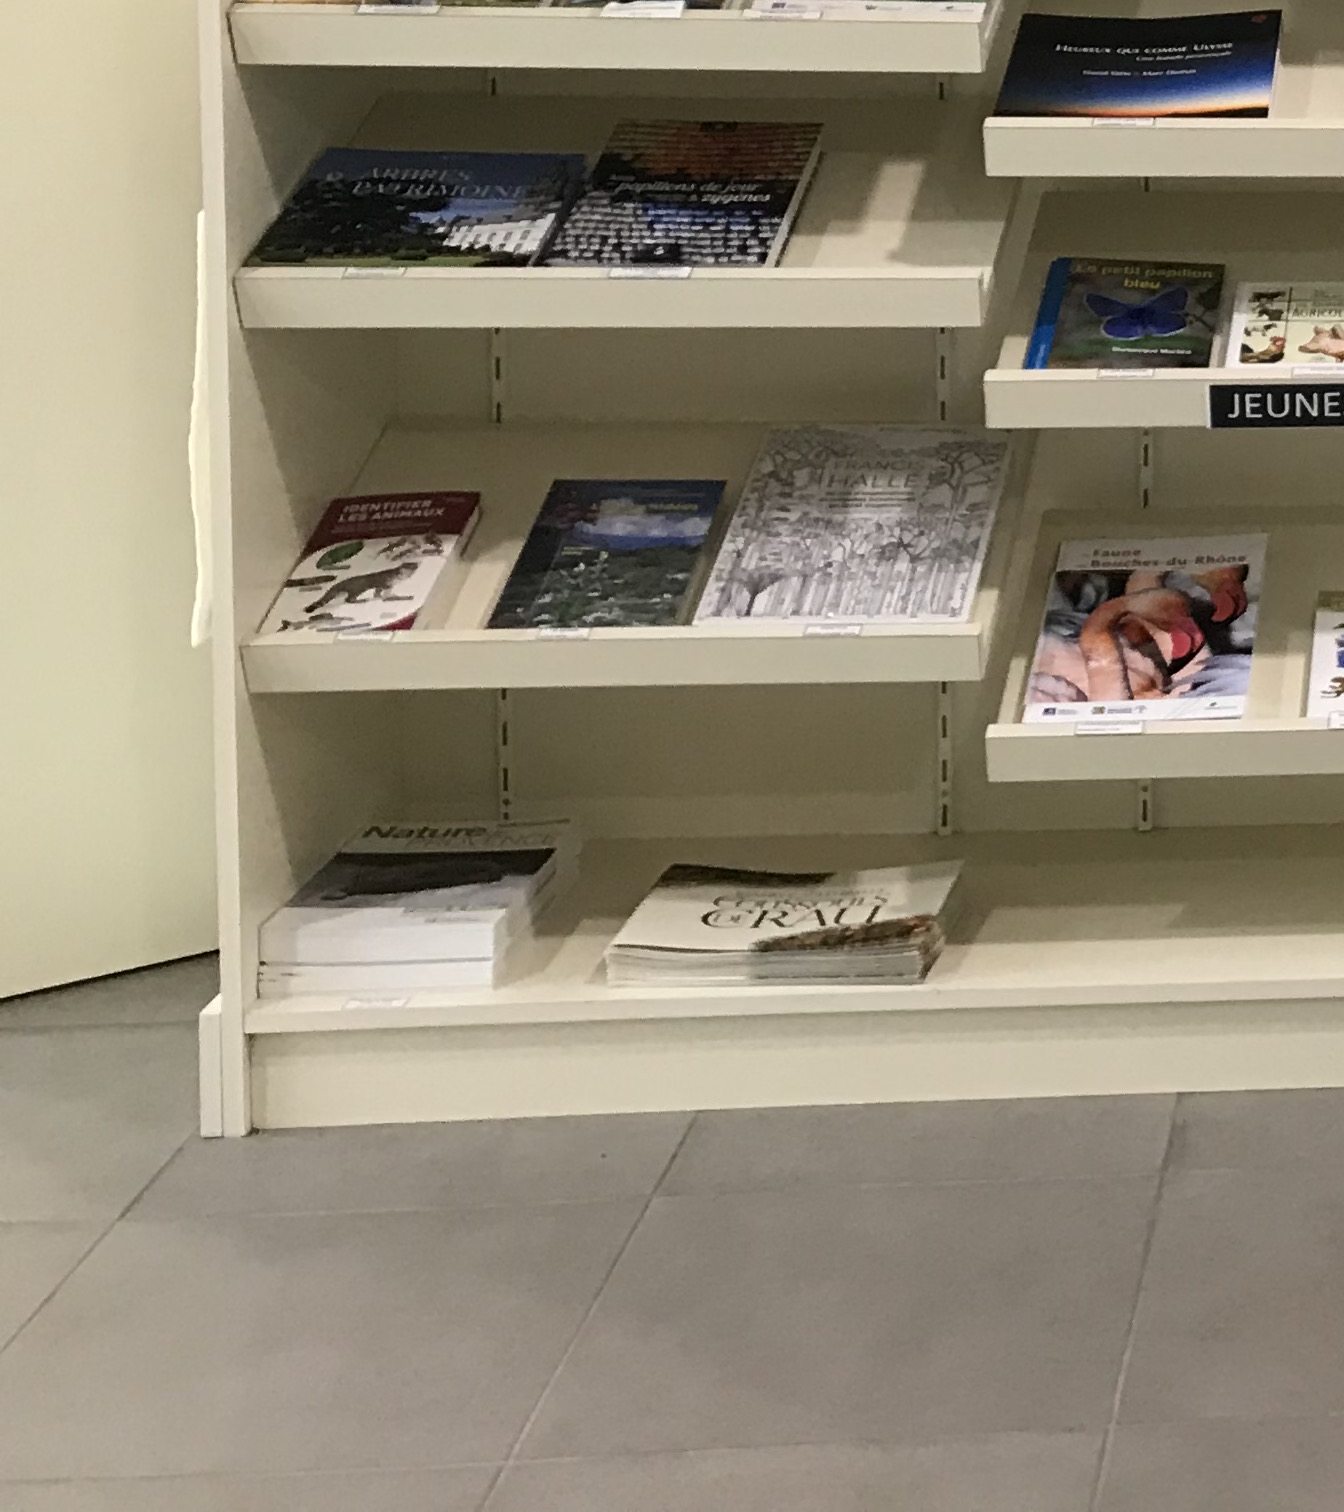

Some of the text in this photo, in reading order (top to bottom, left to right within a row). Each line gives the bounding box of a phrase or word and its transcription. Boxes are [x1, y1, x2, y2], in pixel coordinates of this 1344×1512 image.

[1101, 266, 1140, 277] petit
[1145, 268, 1213, 279] papillon
[1124, 279, 1161, 289] bleu
[342, 500, 433, 514] IDENTIFIER
[337, 506, 445, 523] LES ANIMAUX
[1090, 553, 1246, 567] Bouches du Rhône
[362, 821, 488, 839] Nature
